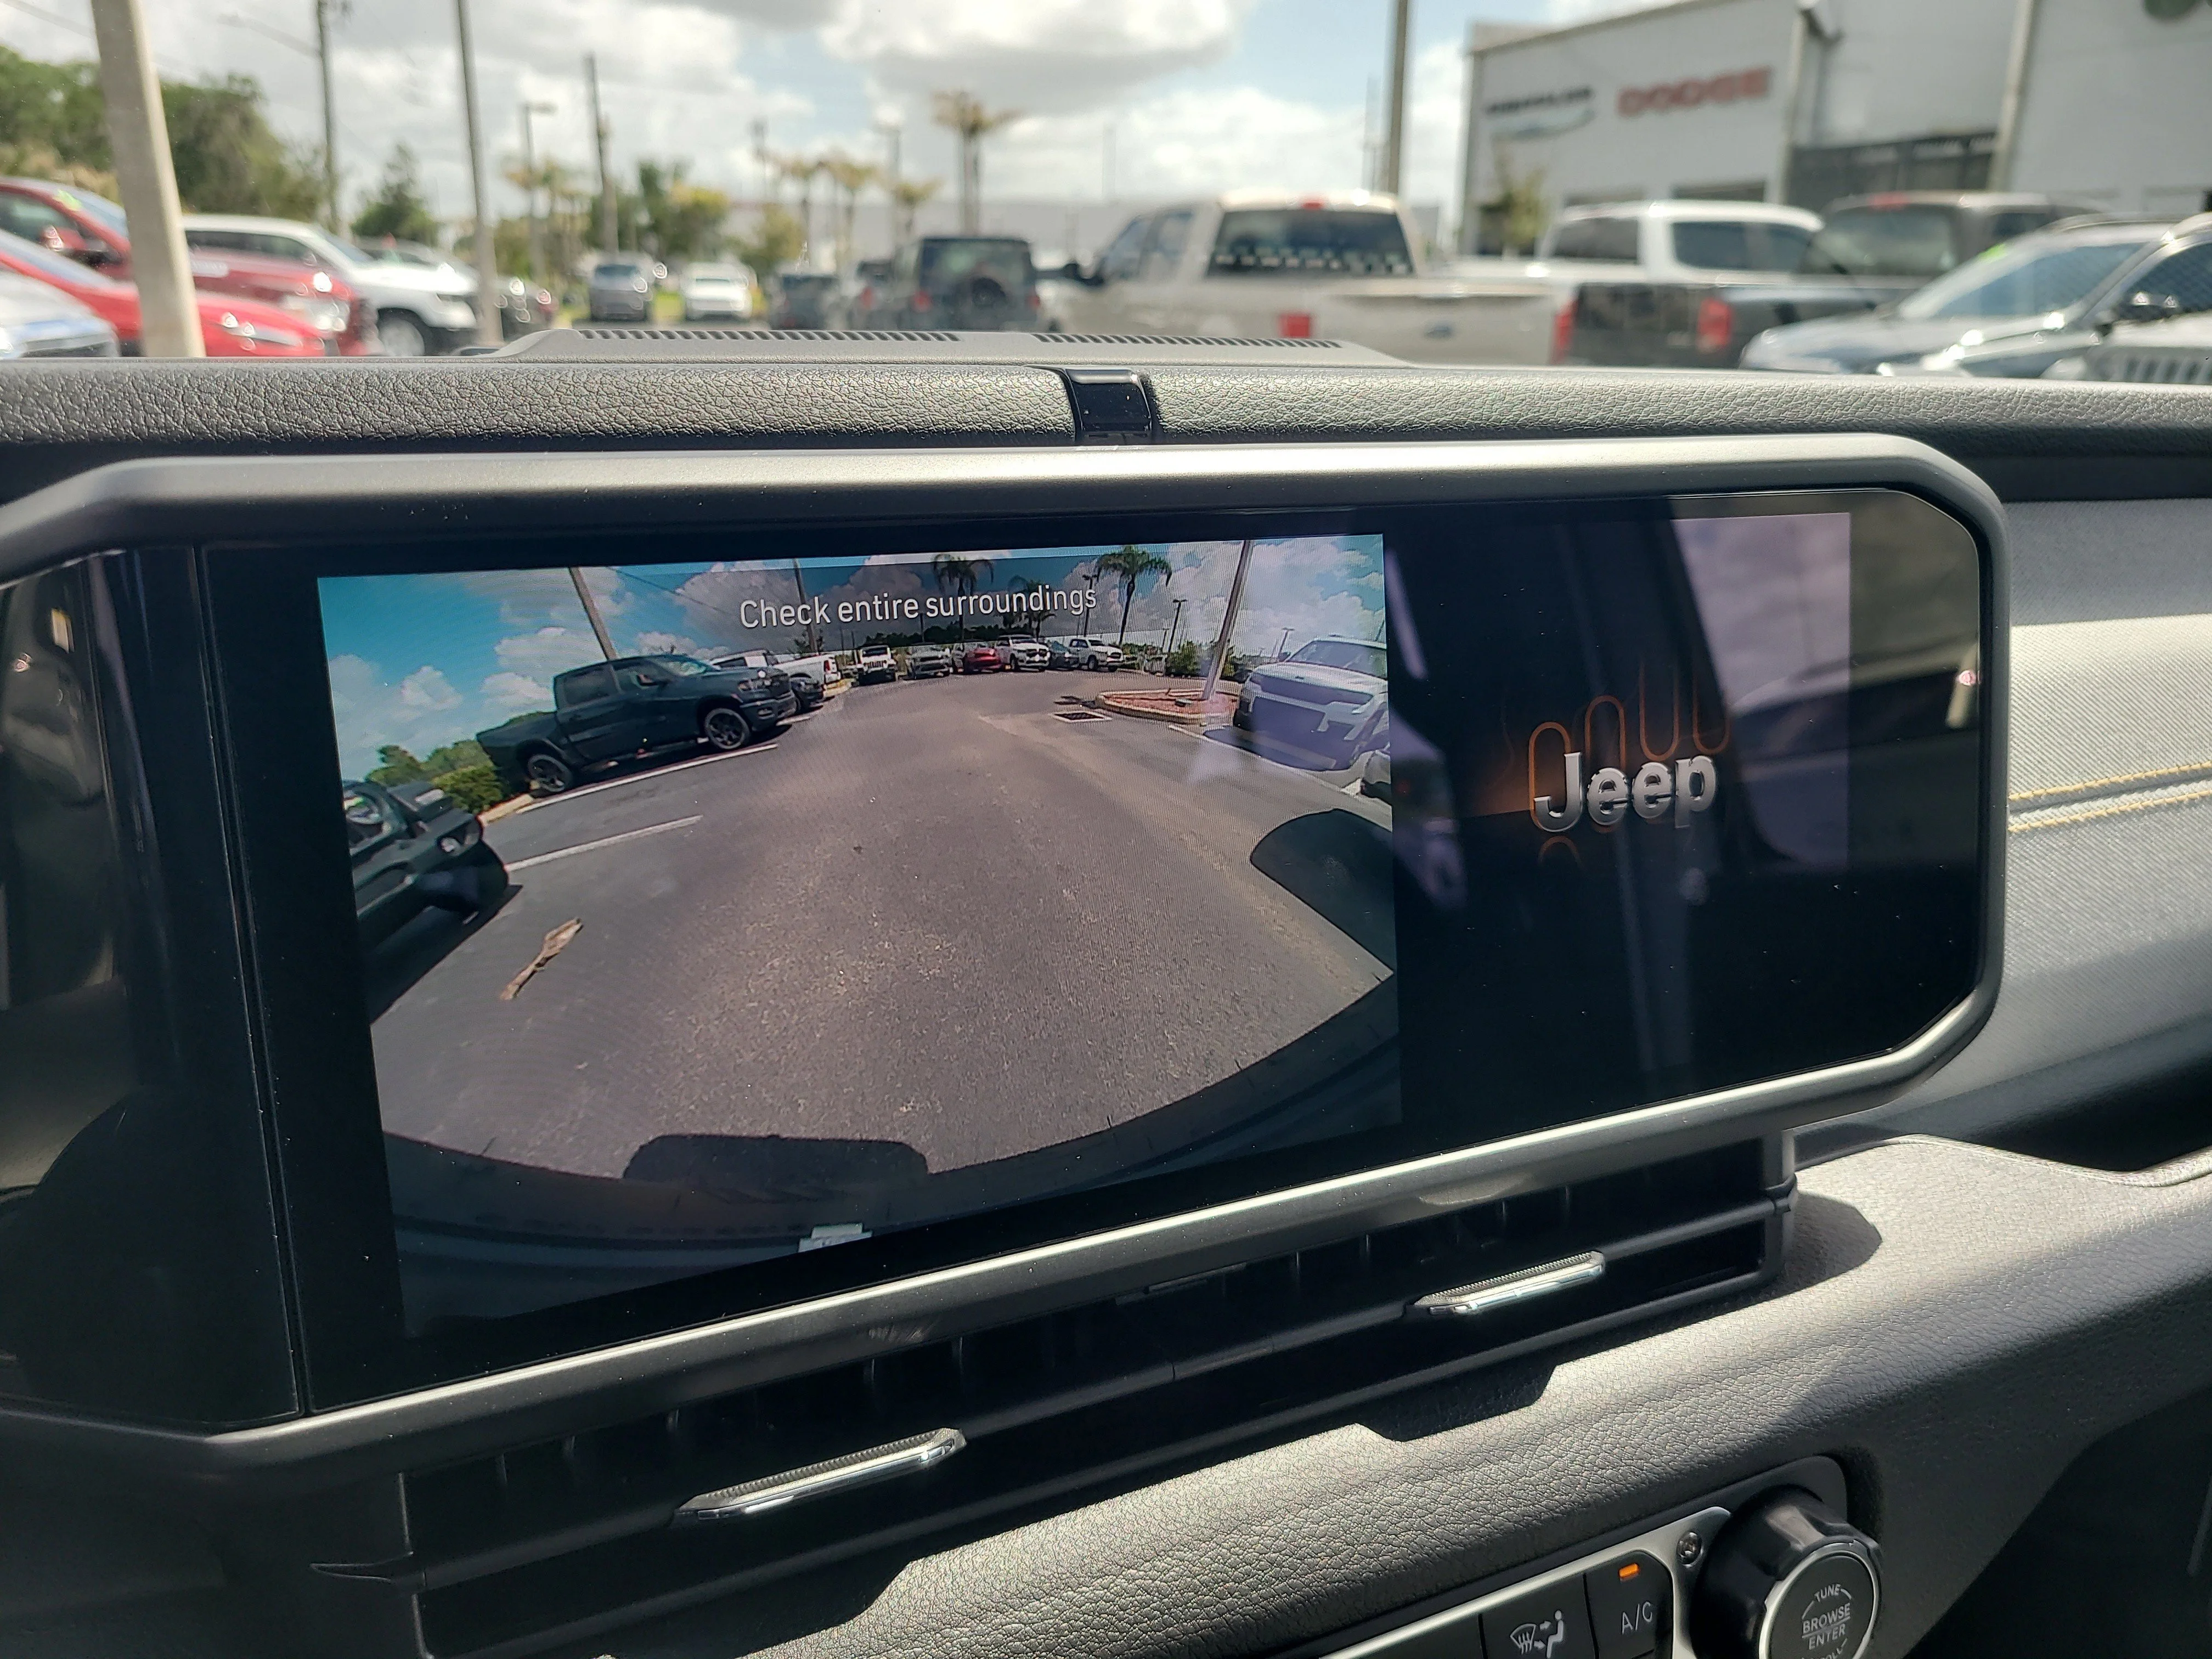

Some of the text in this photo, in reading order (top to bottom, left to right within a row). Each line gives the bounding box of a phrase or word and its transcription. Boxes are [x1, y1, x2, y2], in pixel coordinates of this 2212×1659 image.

[740, 585, 1097, 628] Check entire surroundings
[1534, 752, 1717, 832] Jeep
[1814, 1583, 1841, 1602] TUNE
[1622, 1601, 1652, 1634] A/C
[1803, 1602, 1850, 1634] BROWSE
[1809, 1624, 1846, 1650] ENTER
